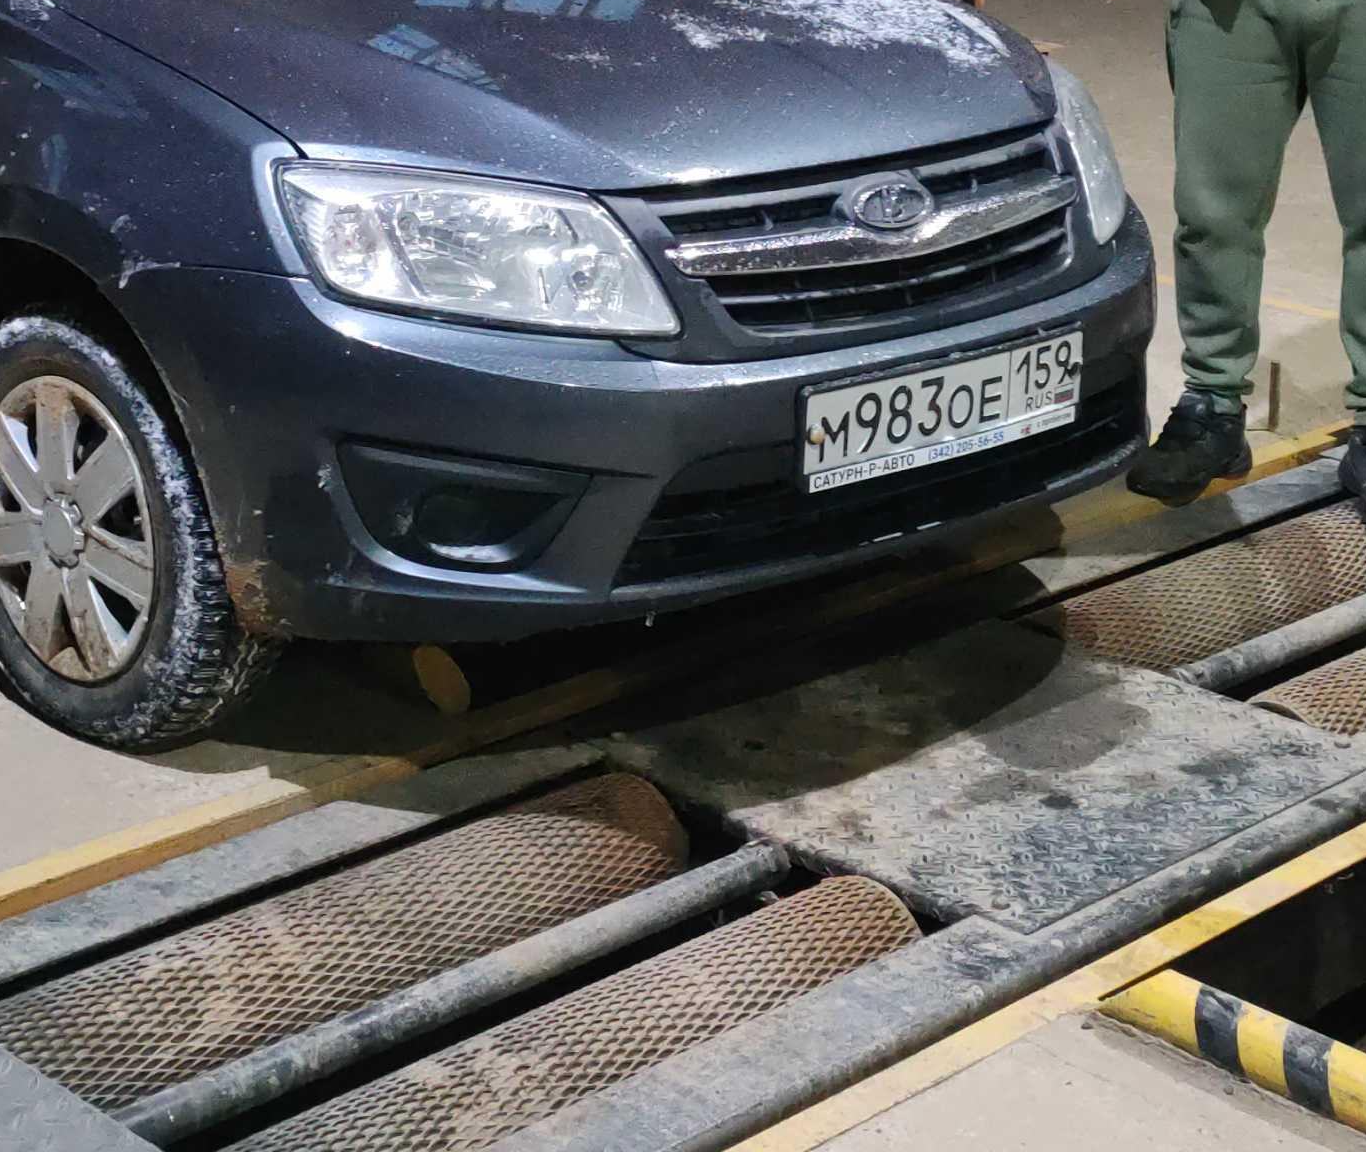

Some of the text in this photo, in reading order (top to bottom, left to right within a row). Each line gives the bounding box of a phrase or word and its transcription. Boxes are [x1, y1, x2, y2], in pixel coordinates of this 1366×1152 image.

[819, 341, 1071, 462] М983ОЕ 159
[1026, 391, 1053, 412] RUS
[813, 453, 916, 489] САТУРН-Р-АВТО
